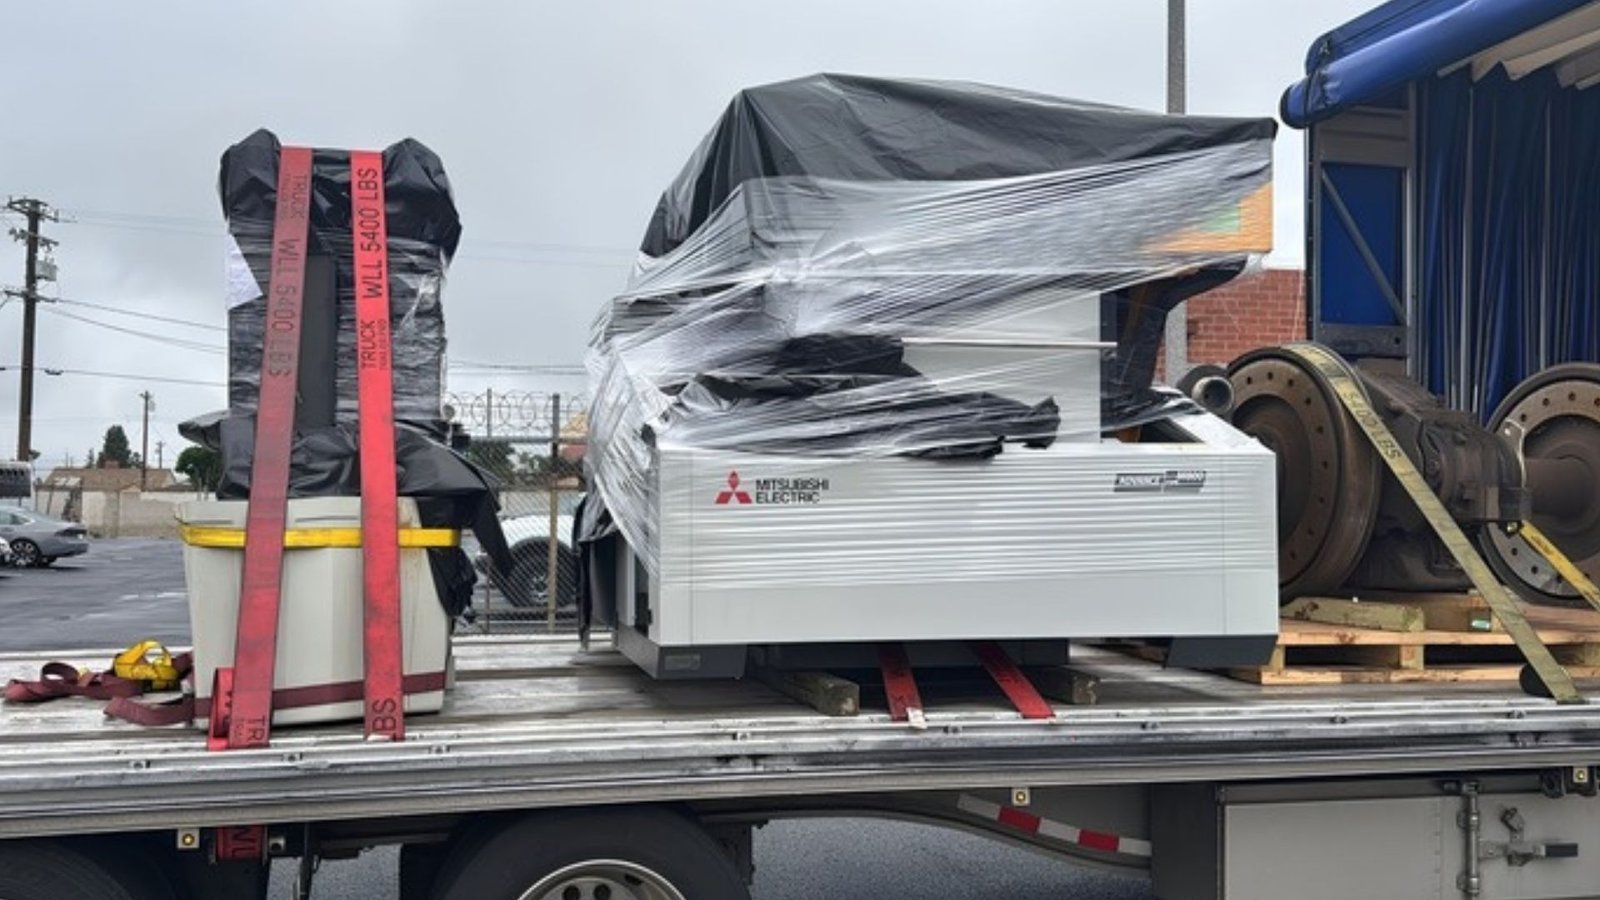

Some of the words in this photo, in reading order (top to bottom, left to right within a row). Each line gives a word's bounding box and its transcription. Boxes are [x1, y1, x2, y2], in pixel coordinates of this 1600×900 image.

[290, 174, 308, 219] TRUCK
[357, 167, 378, 200] LBS
[358, 209, 381, 252] 5400
[277, 238, 300, 274] WLL
[362, 260, 382, 298] WLL
[271, 285, 297, 331] 5400
[360, 320, 377, 369] TRUCK
[756, 478, 829, 490] MITSUBISHI
[756, 491, 820, 504] ELECTRIC
